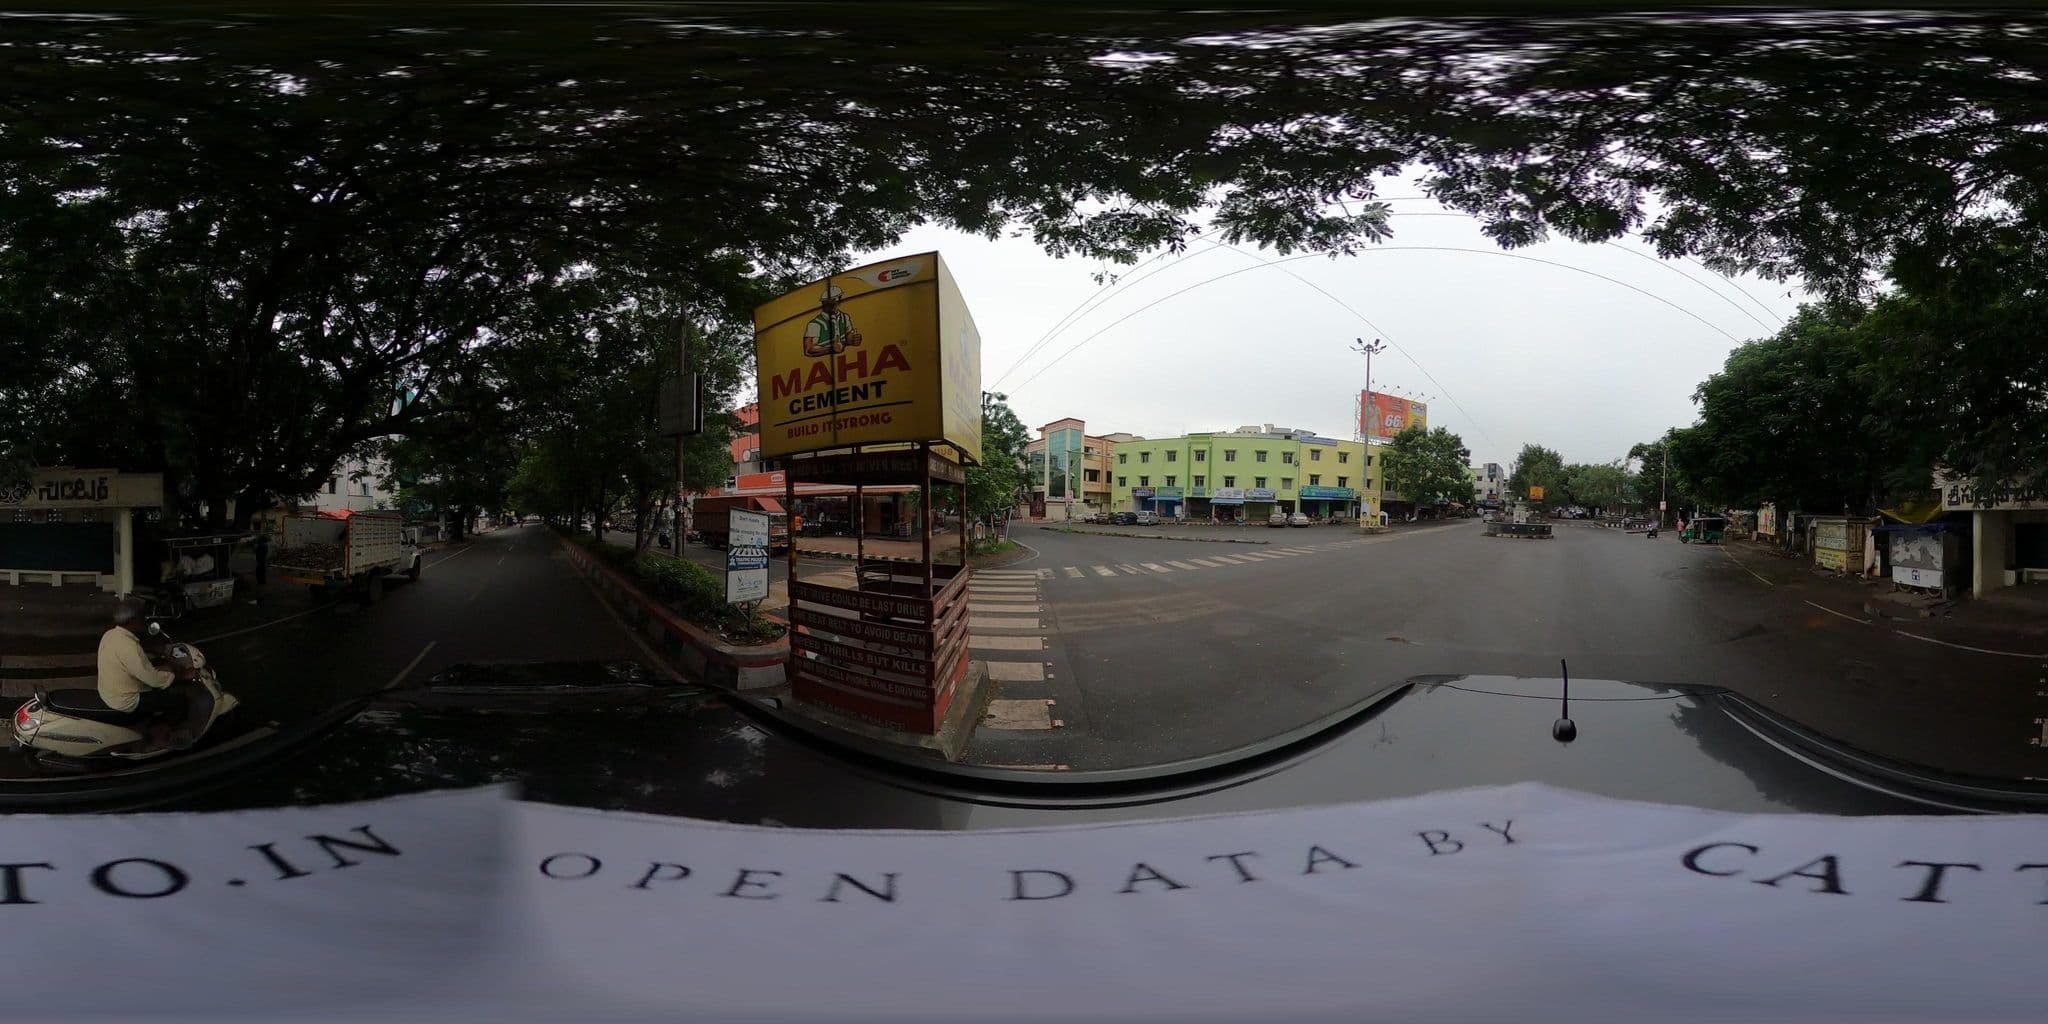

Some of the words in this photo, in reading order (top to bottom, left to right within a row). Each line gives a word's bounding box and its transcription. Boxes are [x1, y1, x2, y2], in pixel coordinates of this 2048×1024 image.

[771, 344, 912, 400] MAHA
[789, 381, 887, 415] CEMENT
[787, 421, 819, 439] BUILD
[822, 419, 833, 433] IT
[835, 412, 892, 431] STRONG
[831, 591, 858, 608] COULD
[859, 597, 871, 609] BE
[872, 599, 896, 613] LAST
[896, 602, 926, 617] DRIVE
[850, 623, 862, 634] TO
[865, 626, 891, 640] AVOID
[893, 631, 926, 645] DEATH
[823, 642, 863, 662] THRILLS
[866, 653, 889, 668] BUT
[892, 659, 927, 674] KILLS
[538, 852, 902, 903] OPEN
[1008, 845, 1361, 901] DATA
[1416, 820, 1521, 856] BY
